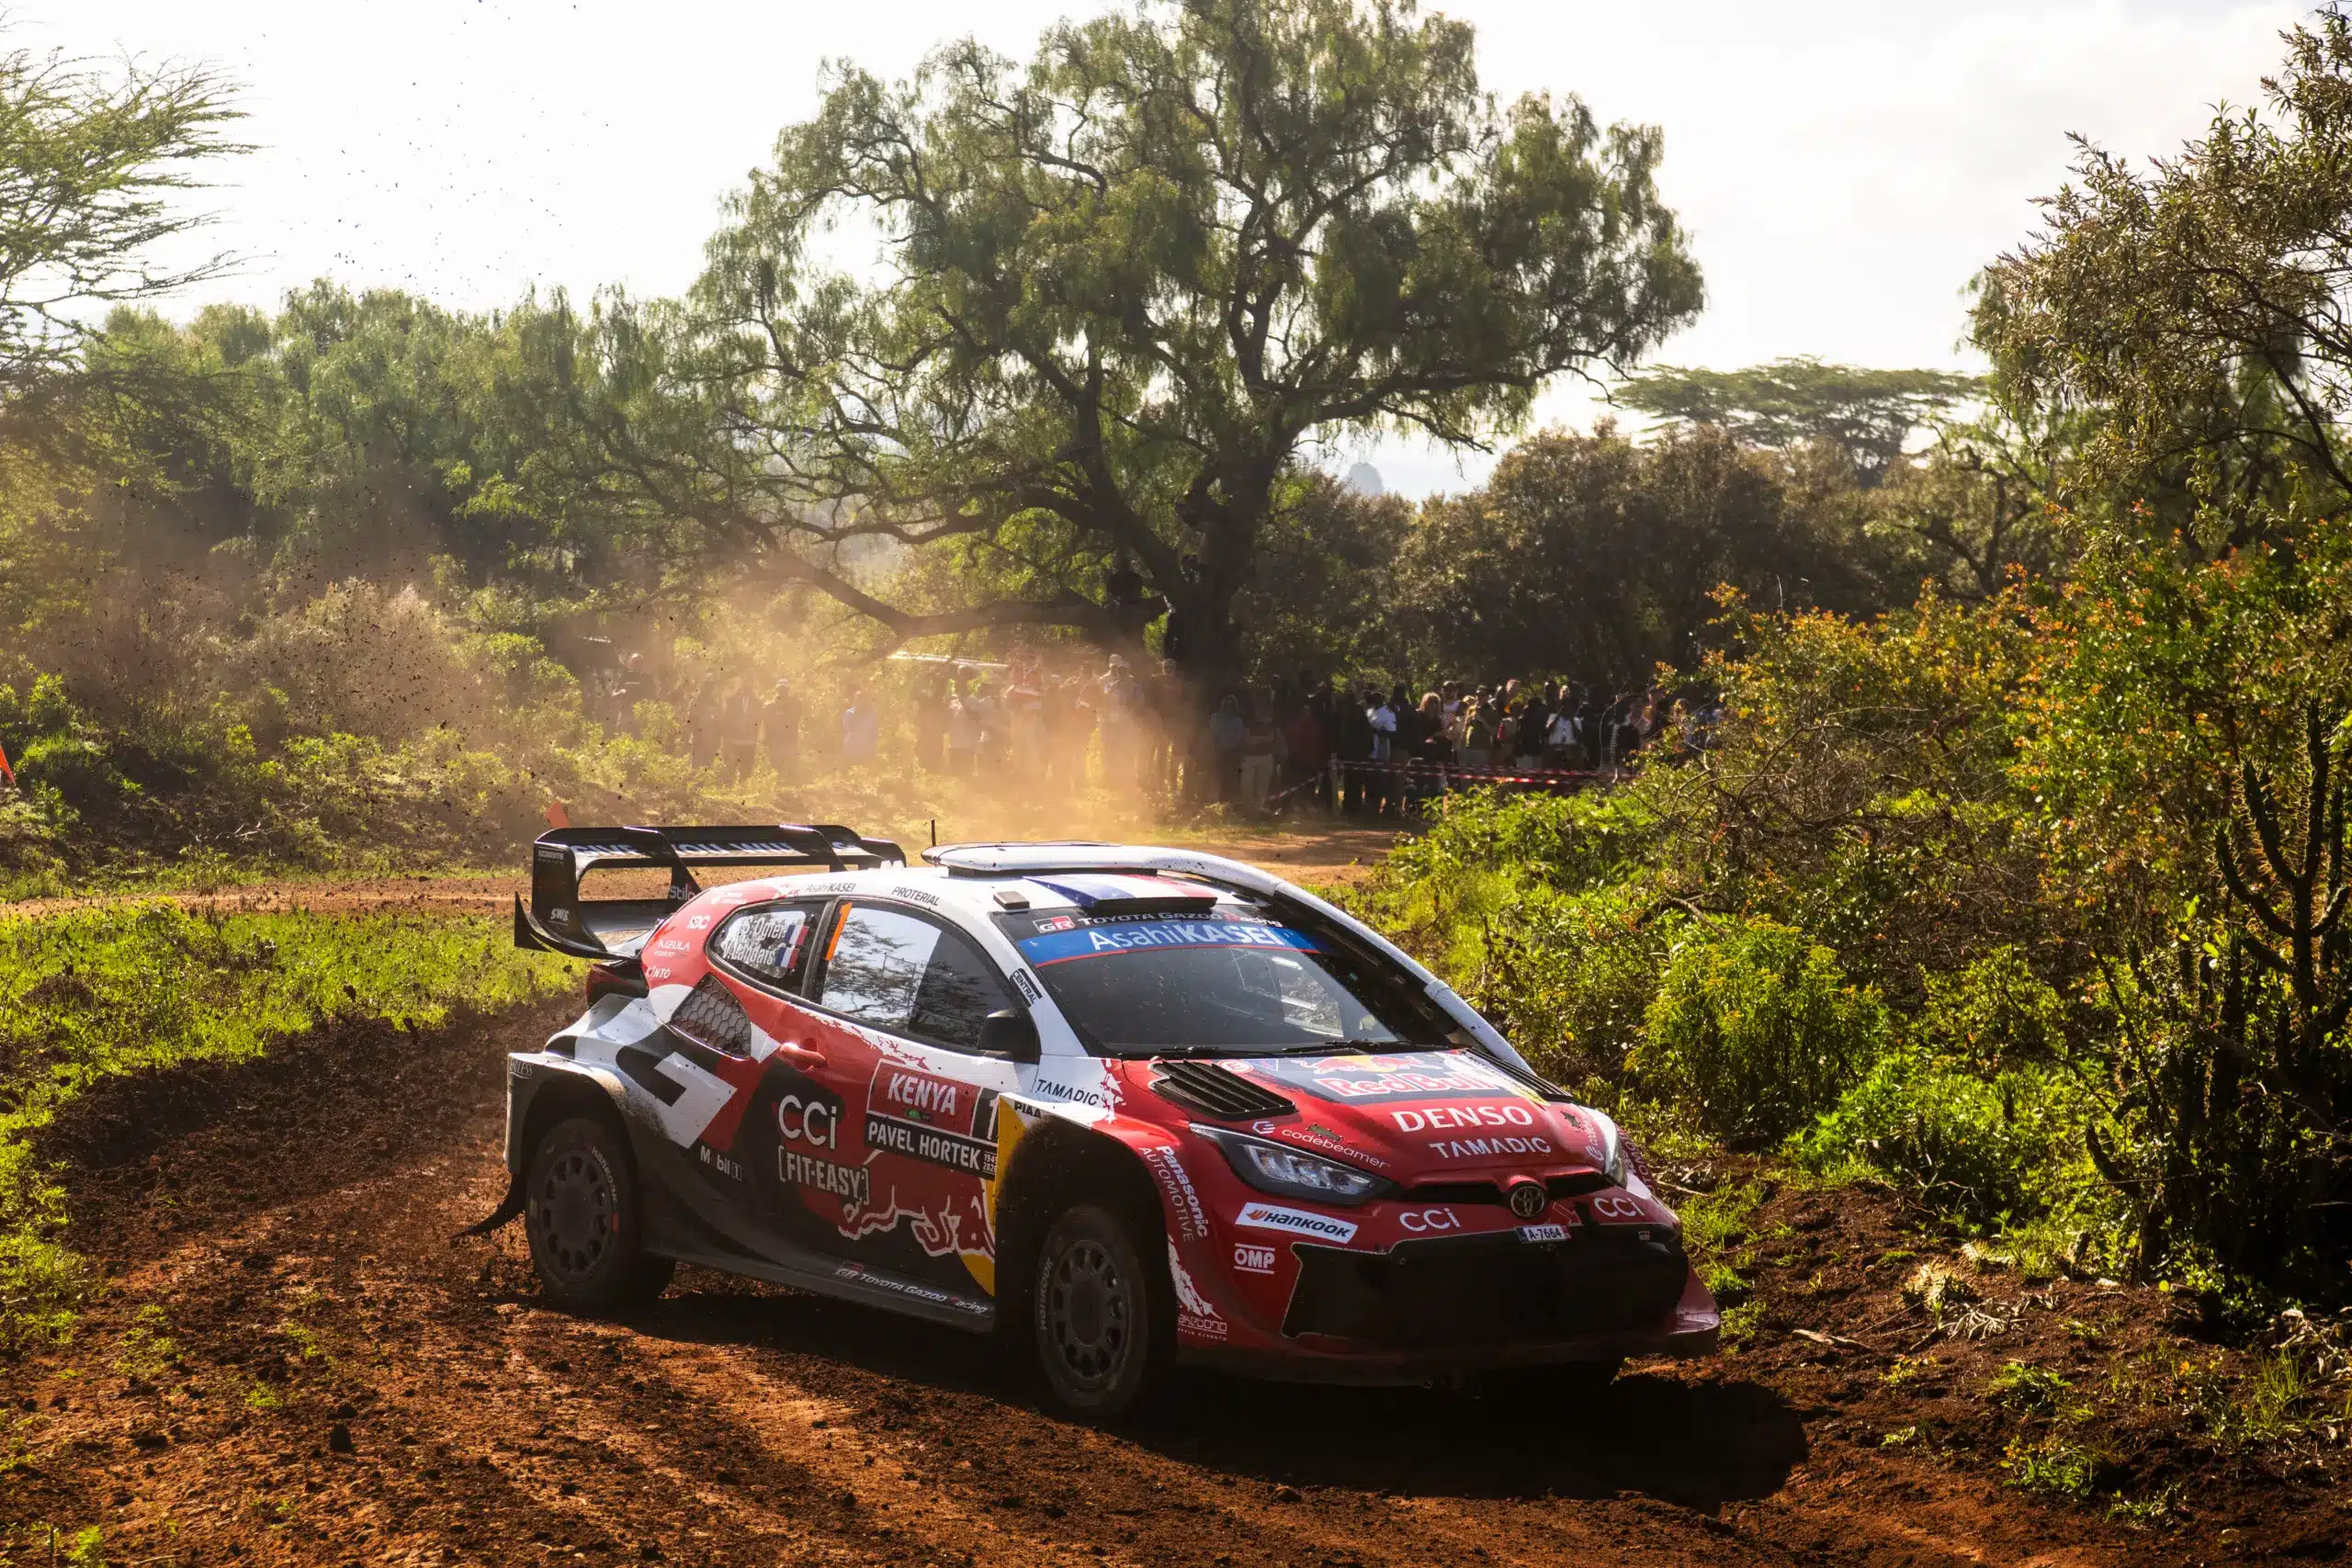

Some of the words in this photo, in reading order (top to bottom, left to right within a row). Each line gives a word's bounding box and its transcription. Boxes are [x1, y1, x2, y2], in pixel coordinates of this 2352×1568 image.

[891, 886, 941, 906] PROTERIAL
[1078, 913, 1155, 926] TOYOTA
[1088, 924, 1285, 951] AsahiKASEI
[1012, 970, 1037, 1004] CENTRAL
[888, 1072, 956, 1116] KENYA
[1037, 1079, 1099, 1106] TAMADIC
[1013, 1100, 1042, 1120] PIAA
[1390, 1105, 1532, 1134] DENSO
[700, 1145, 730, 1175] Mbil
[867, 1121, 915, 1153] PAVEL
[919, 1133, 981, 1171] HORTEK
[1282, 1129, 1387, 1170] codebeamer
[1430, 1137, 1551, 1158] TAMADIC
[1138, 1147, 1194, 1243] AUTOMOTIVE
[1155, 1145, 1208, 1238] Panasonic
[1528, 1227, 1562, 1240] A-7664
[1234, 1248, 1275, 1269] OMP
[858, 1273, 904, 1291] TOYOTA
[903, 1285, 947, 1303] GAZOO
